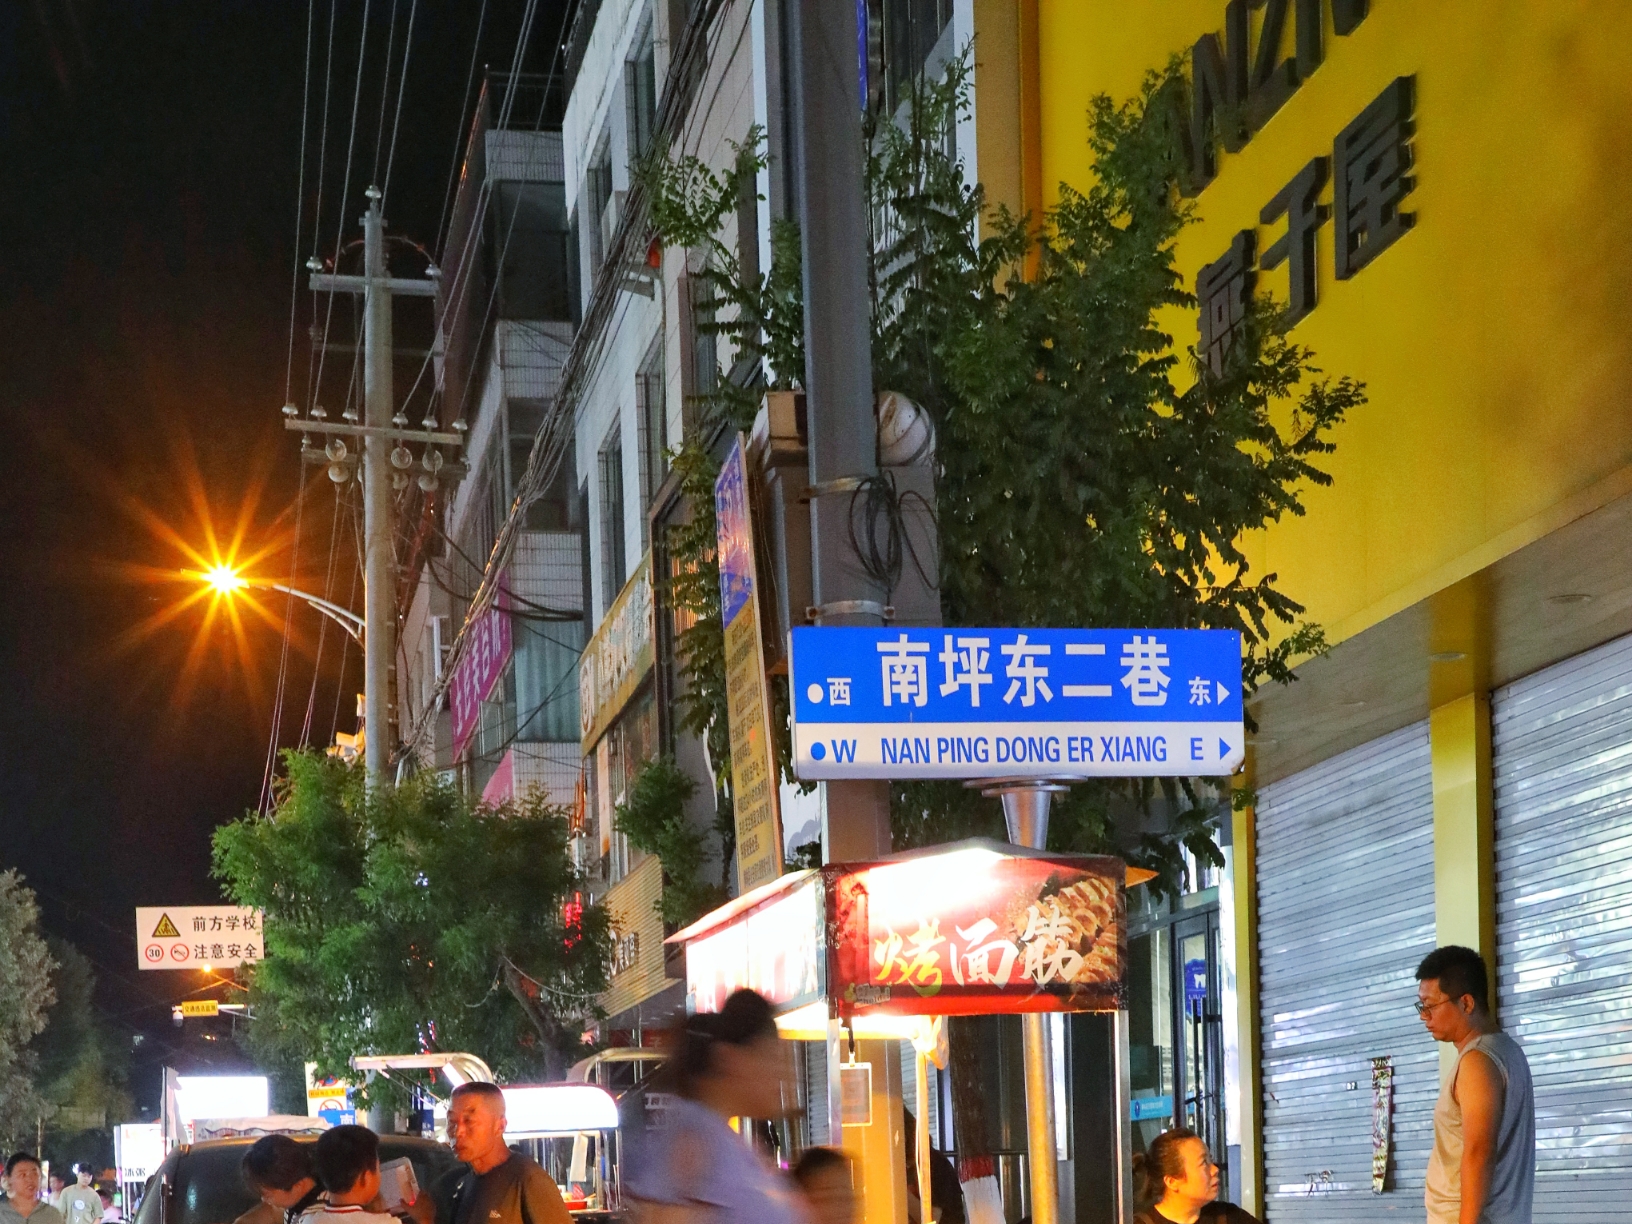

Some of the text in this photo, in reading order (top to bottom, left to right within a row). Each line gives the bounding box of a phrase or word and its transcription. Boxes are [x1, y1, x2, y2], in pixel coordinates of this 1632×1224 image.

[876, 633, 1171, 708] 南坪东二巷
[827, 677, 851, 706] 西
[1188, 676, 1211, 706] 东
[831, 739, 857, 764] W
[881, 735, 1167, 764] NAN PING DONG ER XIANG
[1190, 737, 1204, 761] E
[192, 915, 257, 932] 前方学校
[149, 948, 160, 958] 30
[194, 943, 258, 960] 注意安全
[874, 903, 1083, 997] 烤面筋
